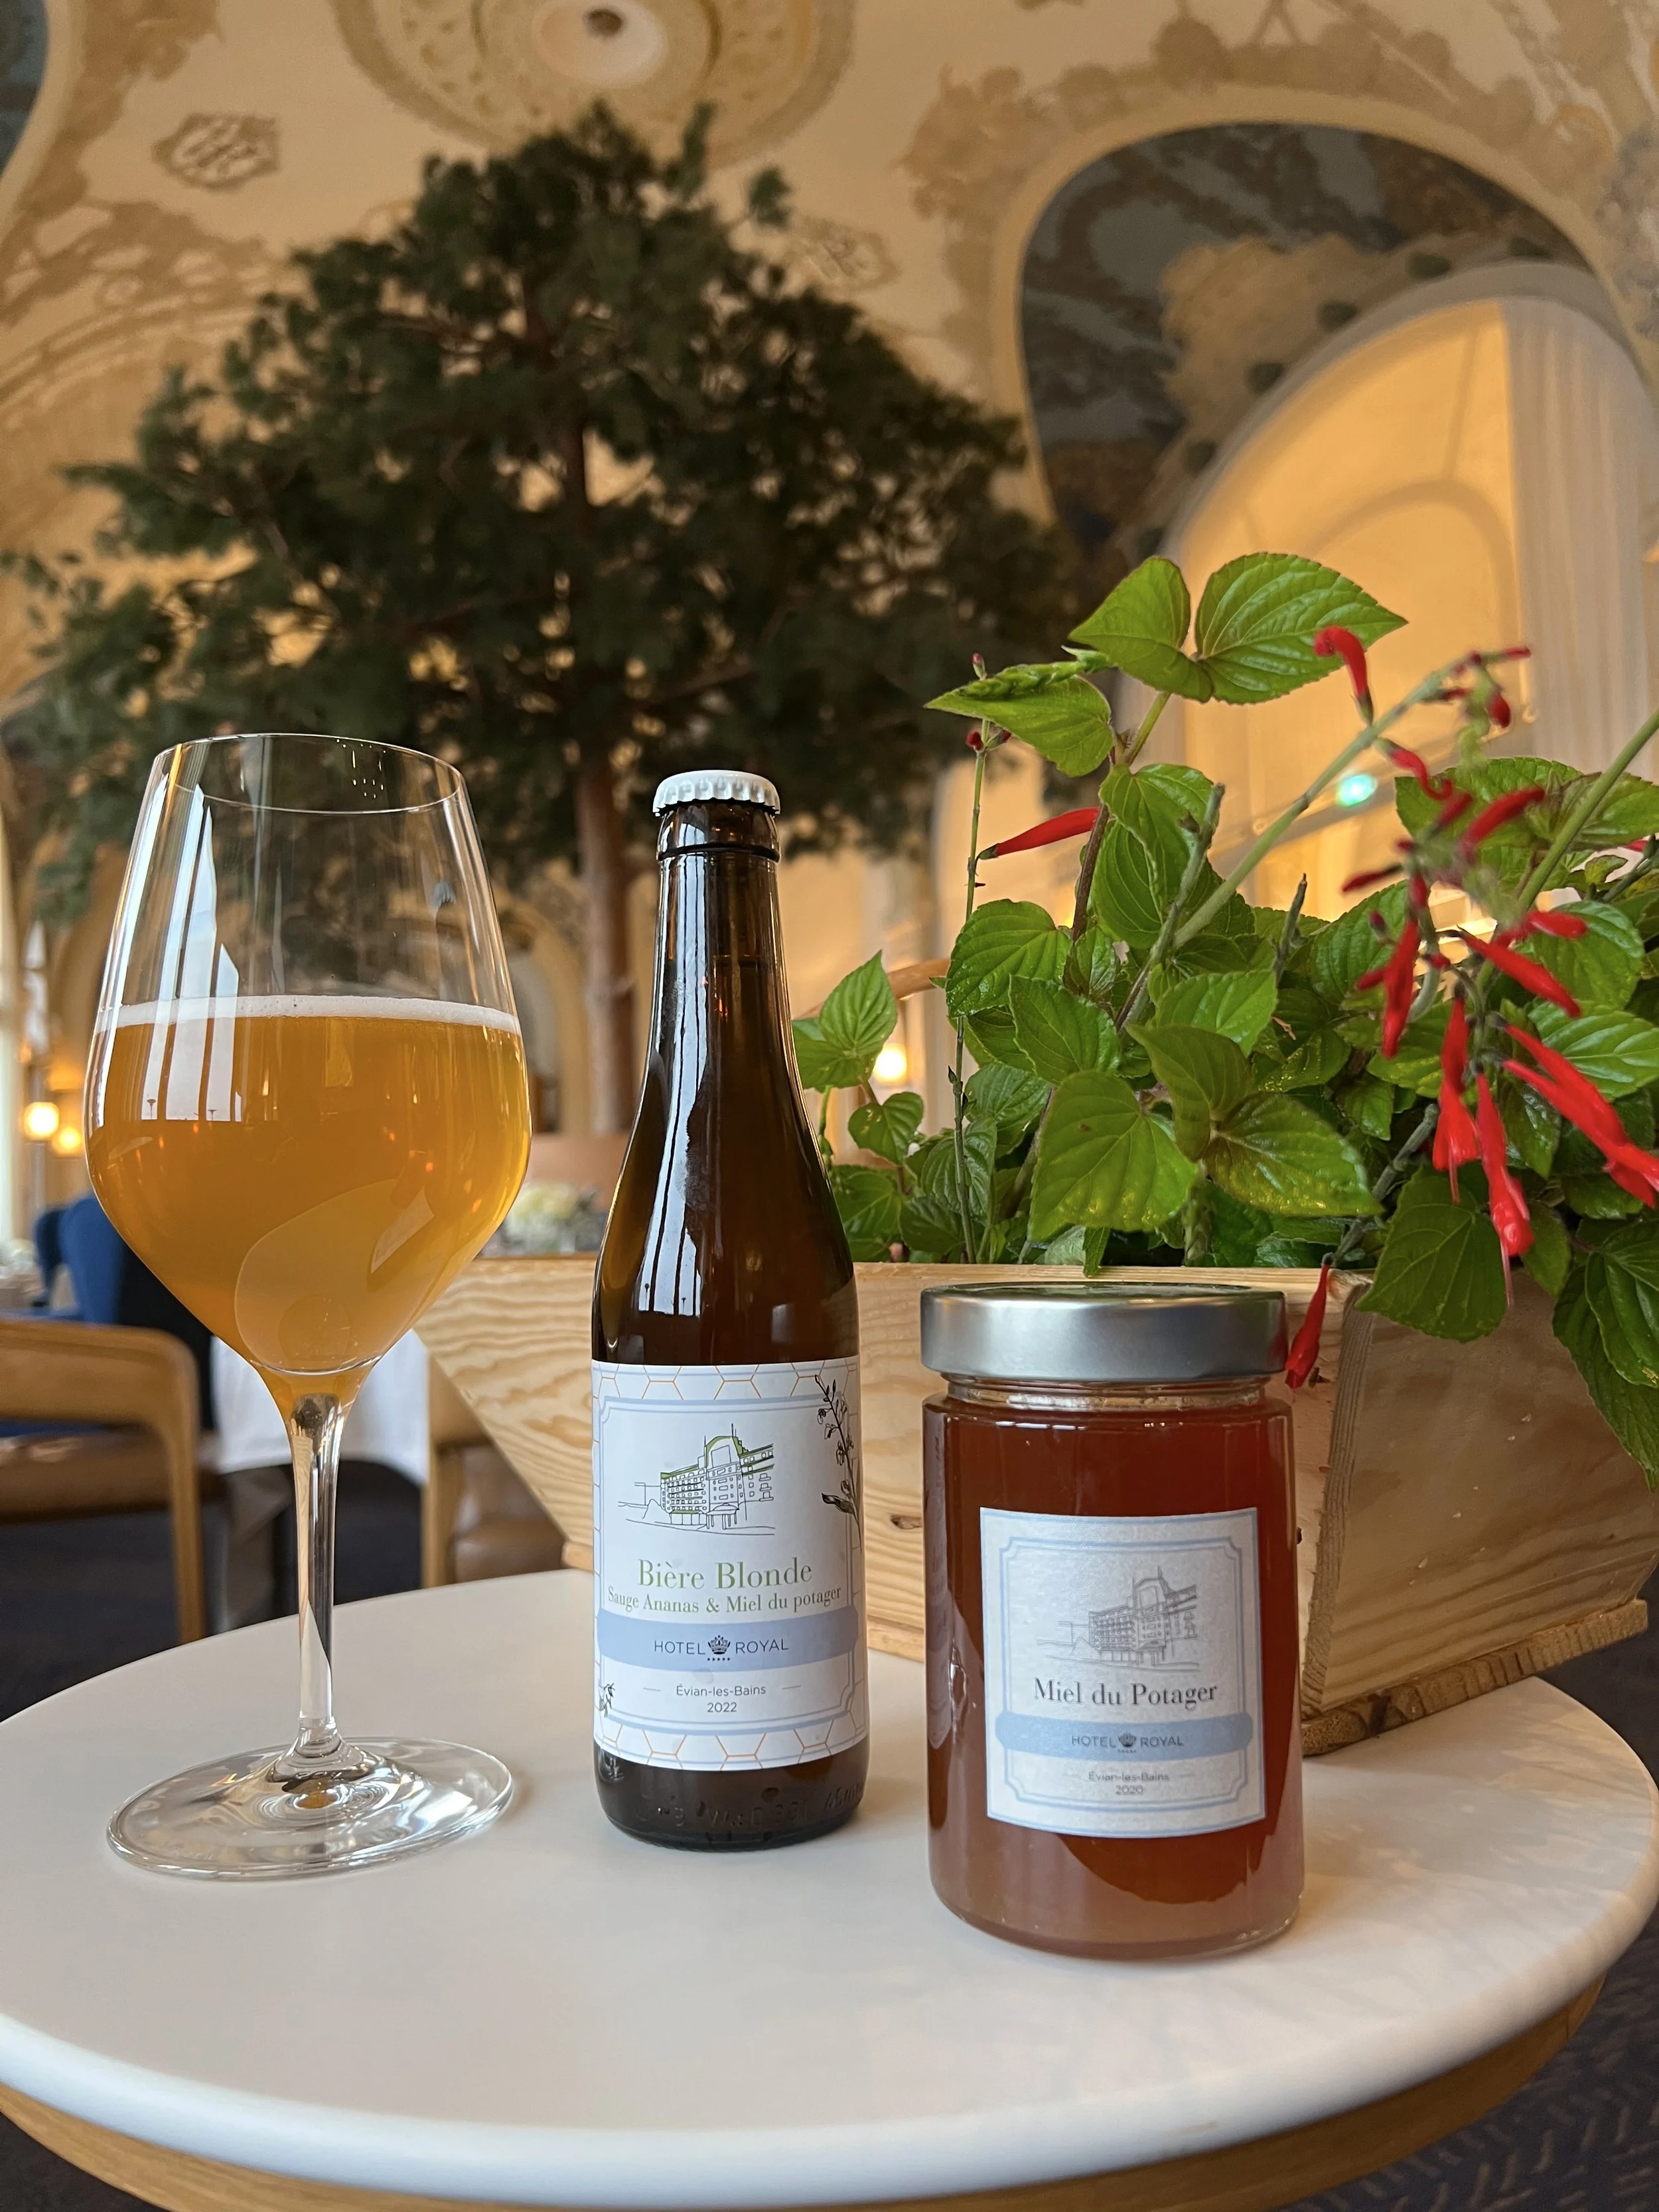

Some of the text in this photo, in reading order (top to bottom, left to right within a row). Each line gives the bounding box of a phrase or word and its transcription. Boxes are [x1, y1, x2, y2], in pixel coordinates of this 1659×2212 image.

[638, 1556, 813, 1589] Bière Blonde
[608, 1585, 842, 1613] Sauge Ananas & Miel du potager
[654, 1638, 789, 1655] HOTEL ROYAL
[676, 1684, 766, 1698] Évian-les-Bains
[1034, 1677, 1218, 1711] Miel du Potager
[707, 1702, 737, 1713] 2022
[1072, 1735, 1184, 1749] HOTEL ROYAL
